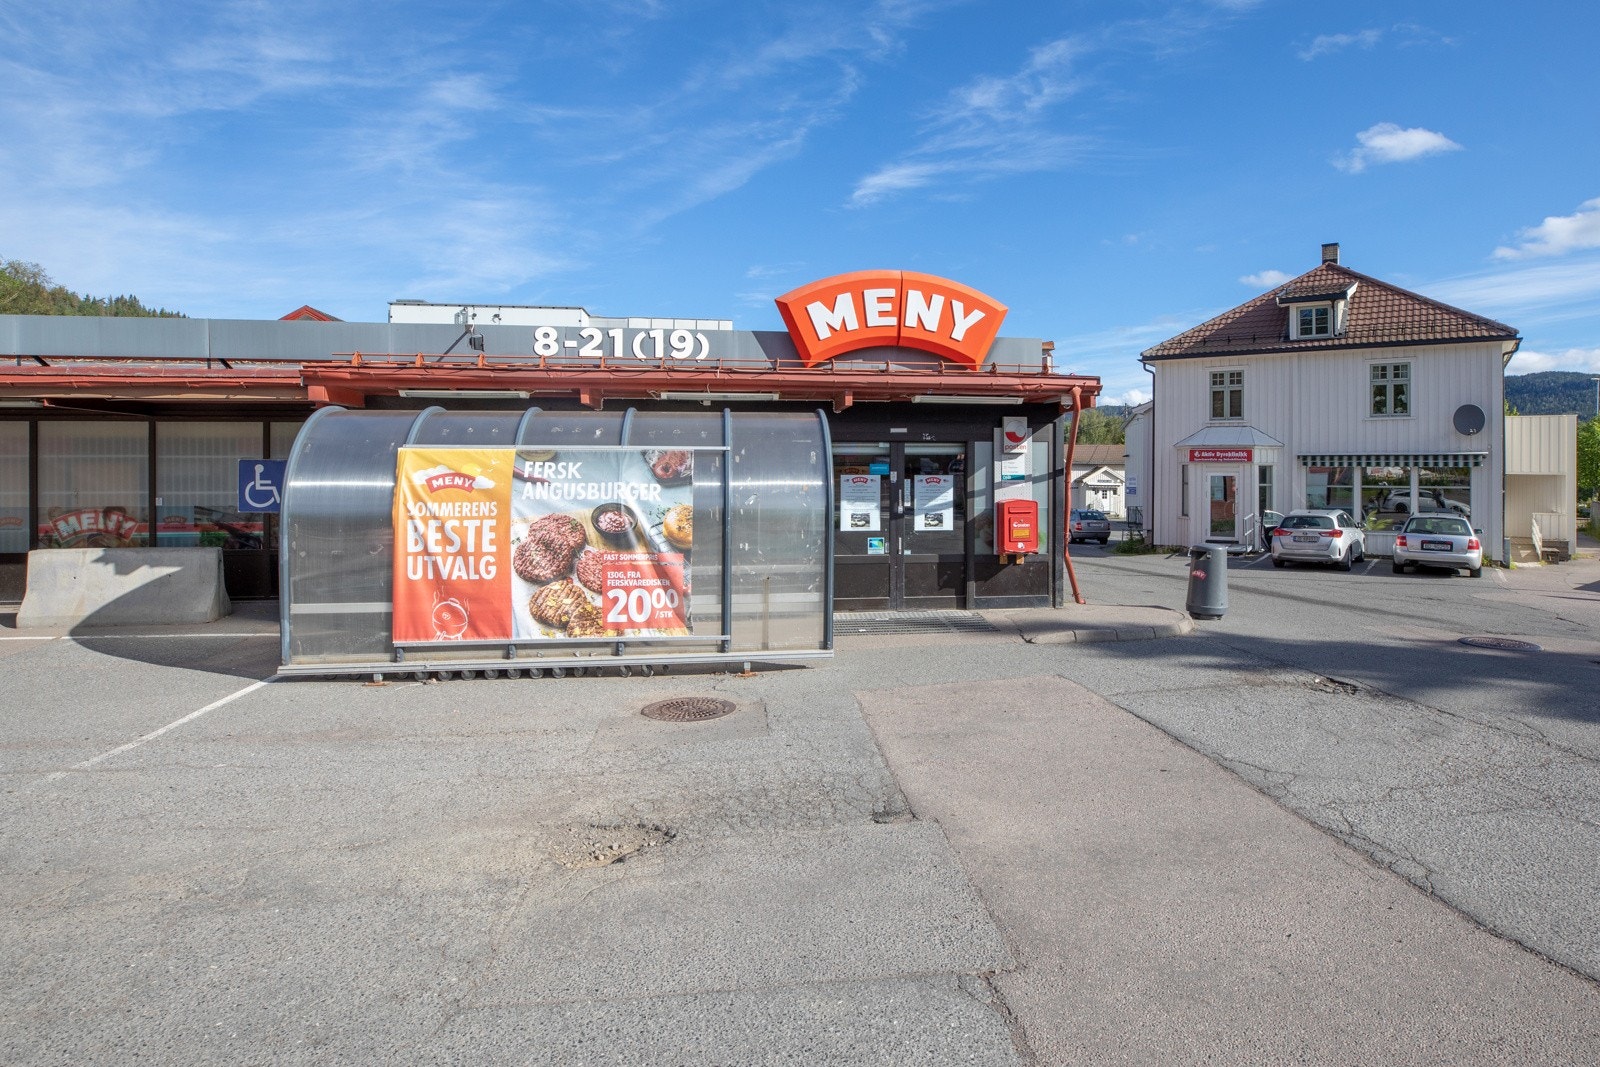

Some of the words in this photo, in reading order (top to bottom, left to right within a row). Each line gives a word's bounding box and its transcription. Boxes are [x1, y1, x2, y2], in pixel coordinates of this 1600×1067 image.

[805, 288, 986, 341] MENY
[523, 461, 582, 480] FERSK
[431, 477, 472, 489] MENY
[521, 482, 662, 501] ANGUSBURGER
[407, 501, 497, 517] SOMMERENS
[56, 510, 136, 538] MENY
[406, 519, 497, 553] BESTE
[406, 556, 497, 580] UTVALG
[627, 571, 641, 579] FRA
